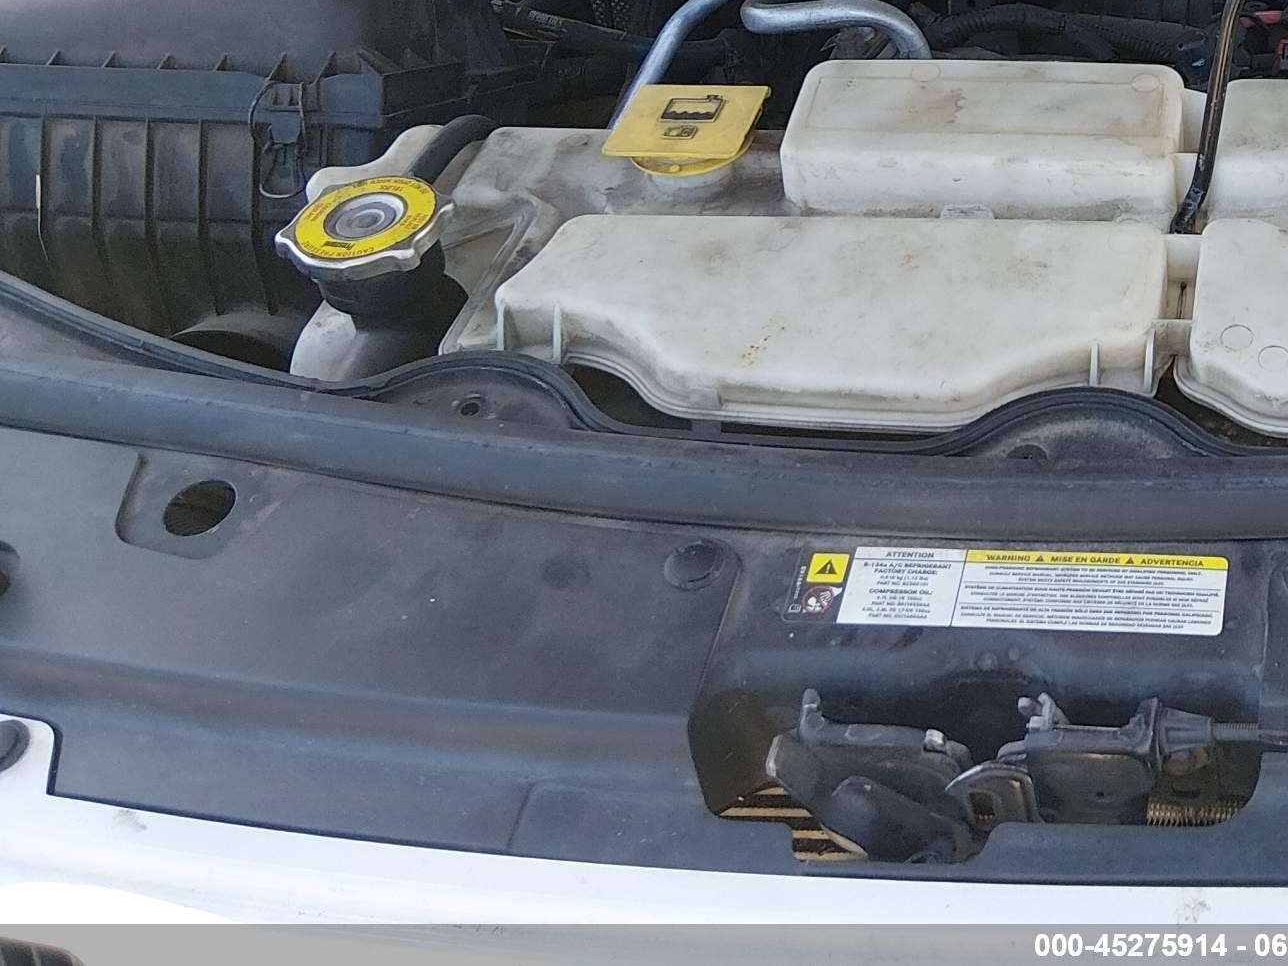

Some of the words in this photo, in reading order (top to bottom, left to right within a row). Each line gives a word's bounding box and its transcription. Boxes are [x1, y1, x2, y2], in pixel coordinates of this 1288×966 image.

[335, 246, 375, 257] CAUTION
[886, 551, 935, 559] ATTENTION
[985, 553, 1031, 562] WARNING
[1050, 555, 1073, 563] MISE
[1075, 555, 1088, 563] EN
[1090, 556, 1121, 564] GARDE
[1140, 558, 1204, 567] ADVERTENCIA
